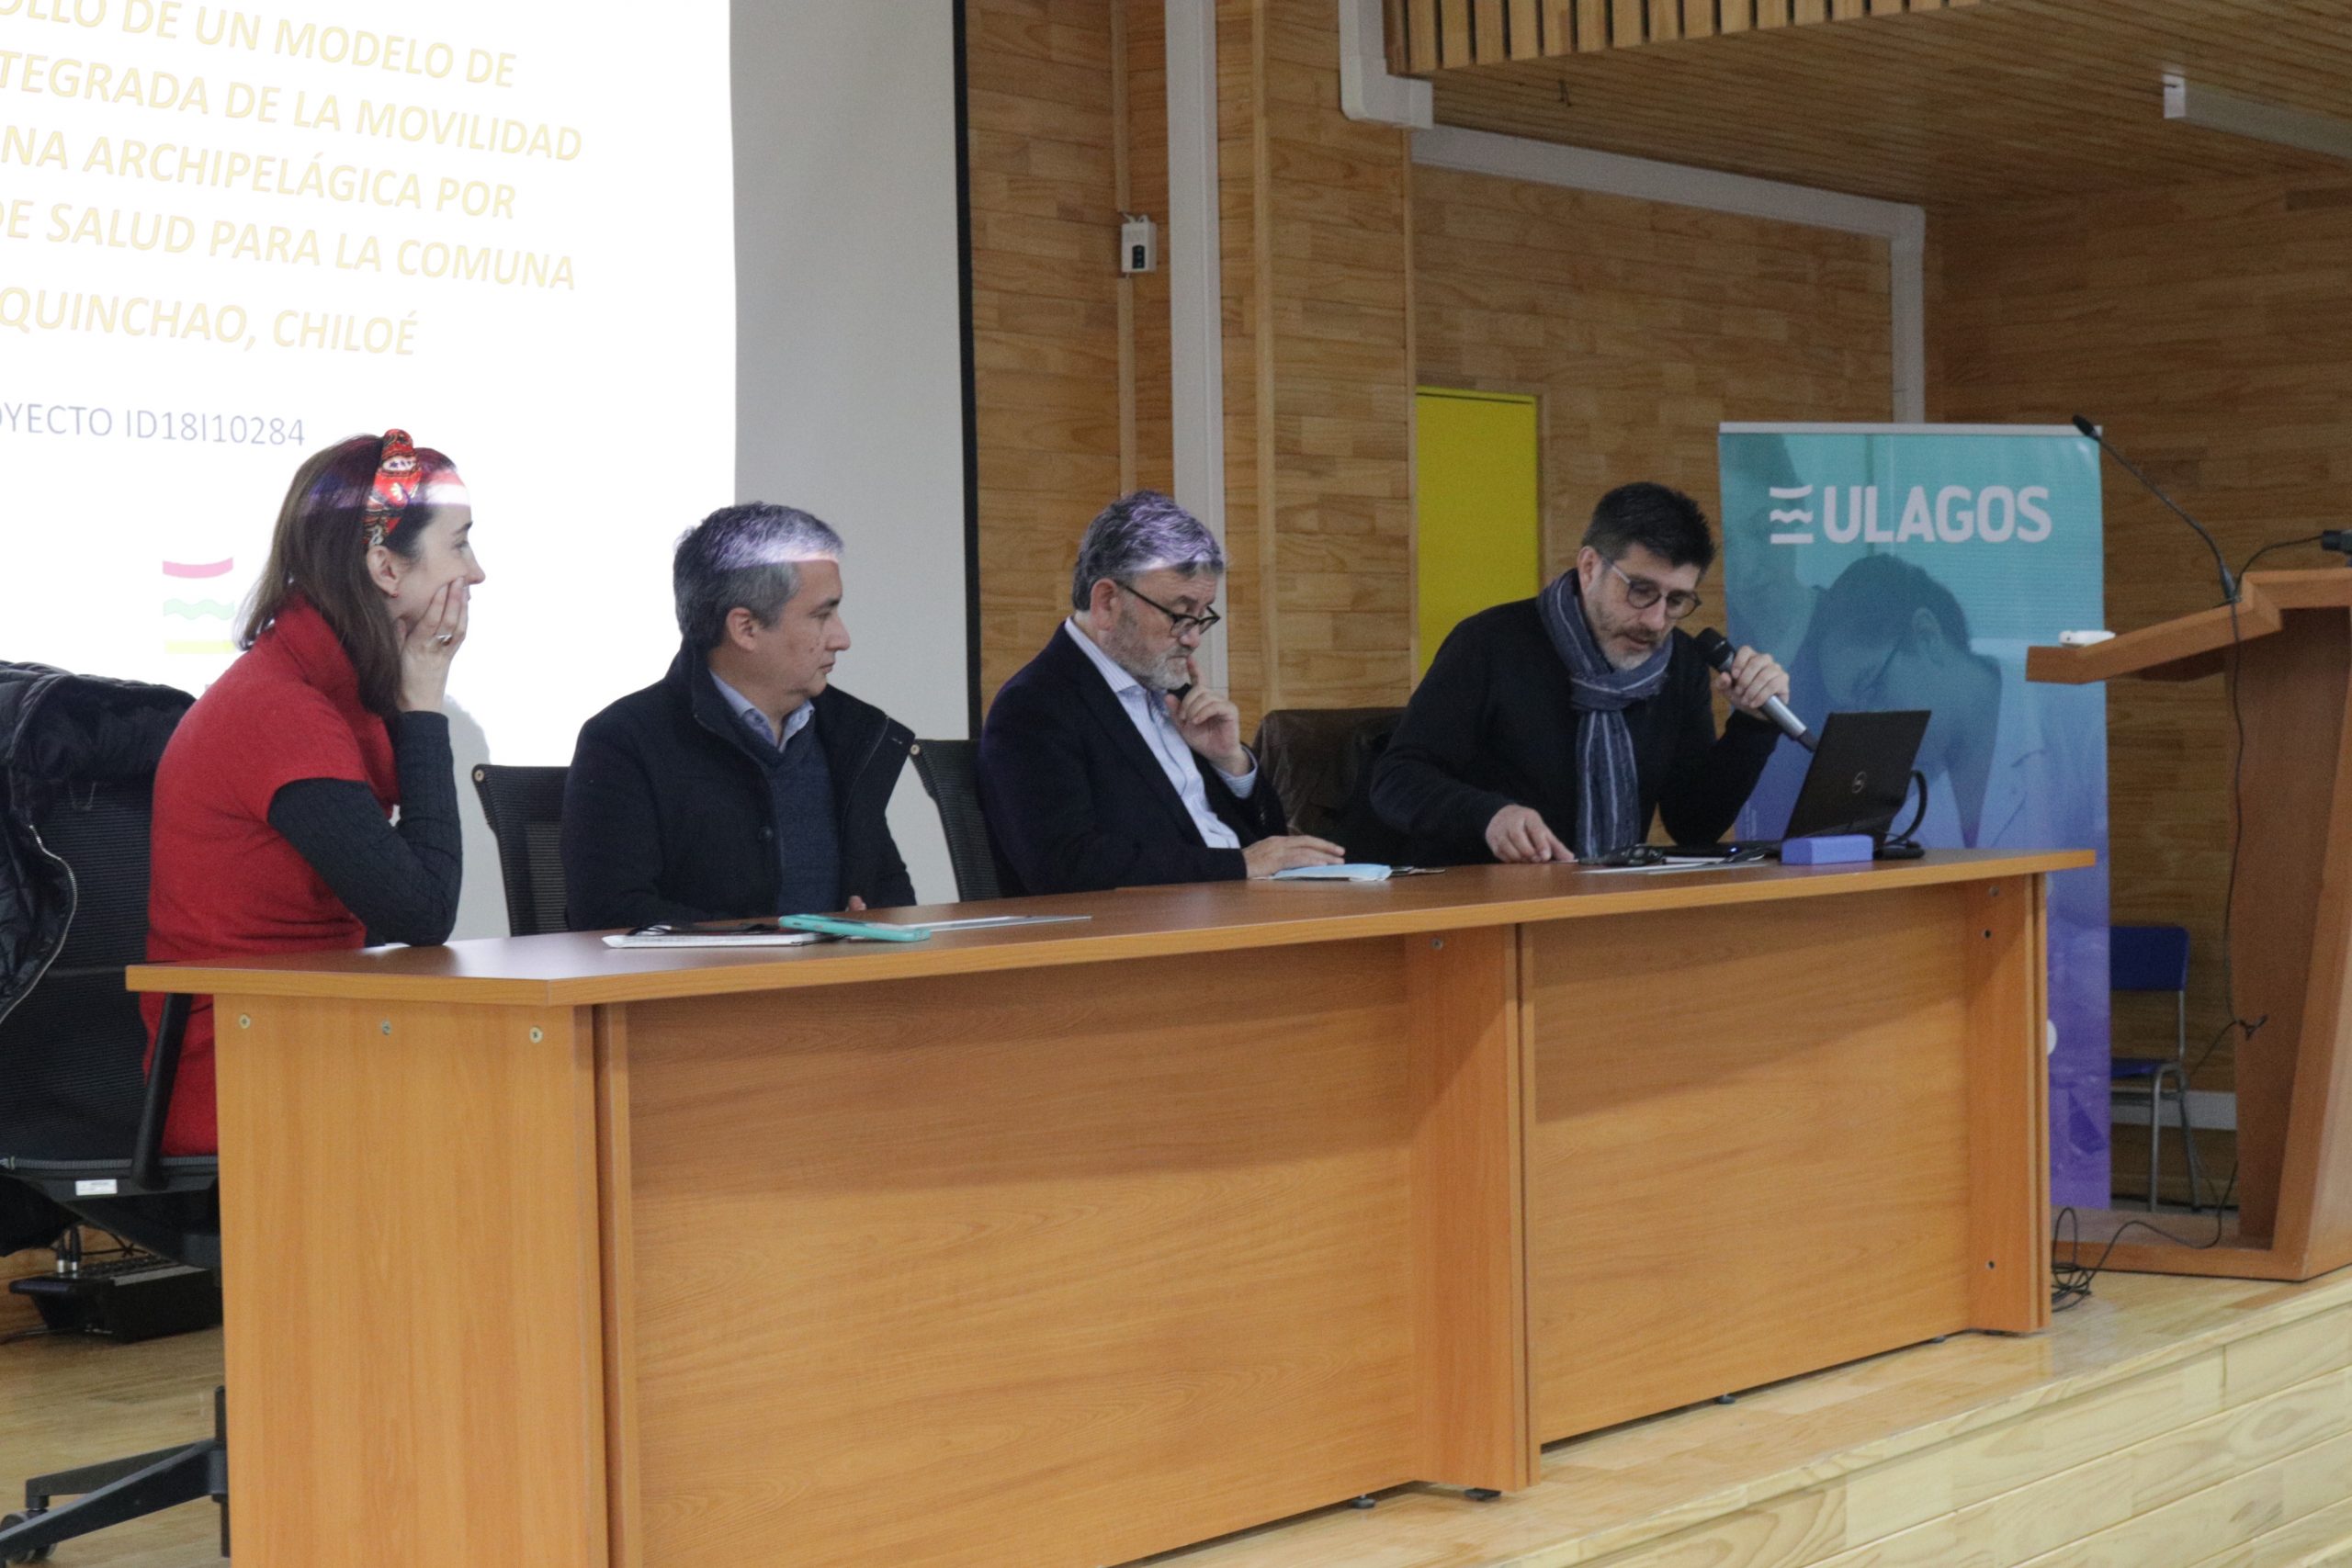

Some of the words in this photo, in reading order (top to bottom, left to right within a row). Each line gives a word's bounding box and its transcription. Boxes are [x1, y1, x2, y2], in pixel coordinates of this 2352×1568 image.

[122, 0, 182, 39] DE
[196, 6, 261, 51] UN
[275, 19, 454, 79] MODELO
[466, 49, 516, 88] DE
[0, 50, 209, 115] TEGRADA
[225, 82, 281, 123] DE
[294, 90, 341, 131] LA
[356, 99, 582, 162] MOVILIDAD
[1, 125, 68, 170] NA
[82, 136, 422, 209] ARCHIPELÁGICA
[435, 176, 515, 220] POR
[0, 199, 34, 239] E
[46, 202, 195, 254] SALUD
[209, 220, 321, 265] PARA
[335, 233, 381, 272] LA
[397, 239, 574, 290] COMUNA
[0, 287, 255, 351] QUINCHAO,
[273, 310, 419, 355] CHILOÉ
[0, 402, 112, 436] YECTO
[126, 410, 305, 446] ID18I10284
[1824, 486, 2052, 543] ULAGOS
